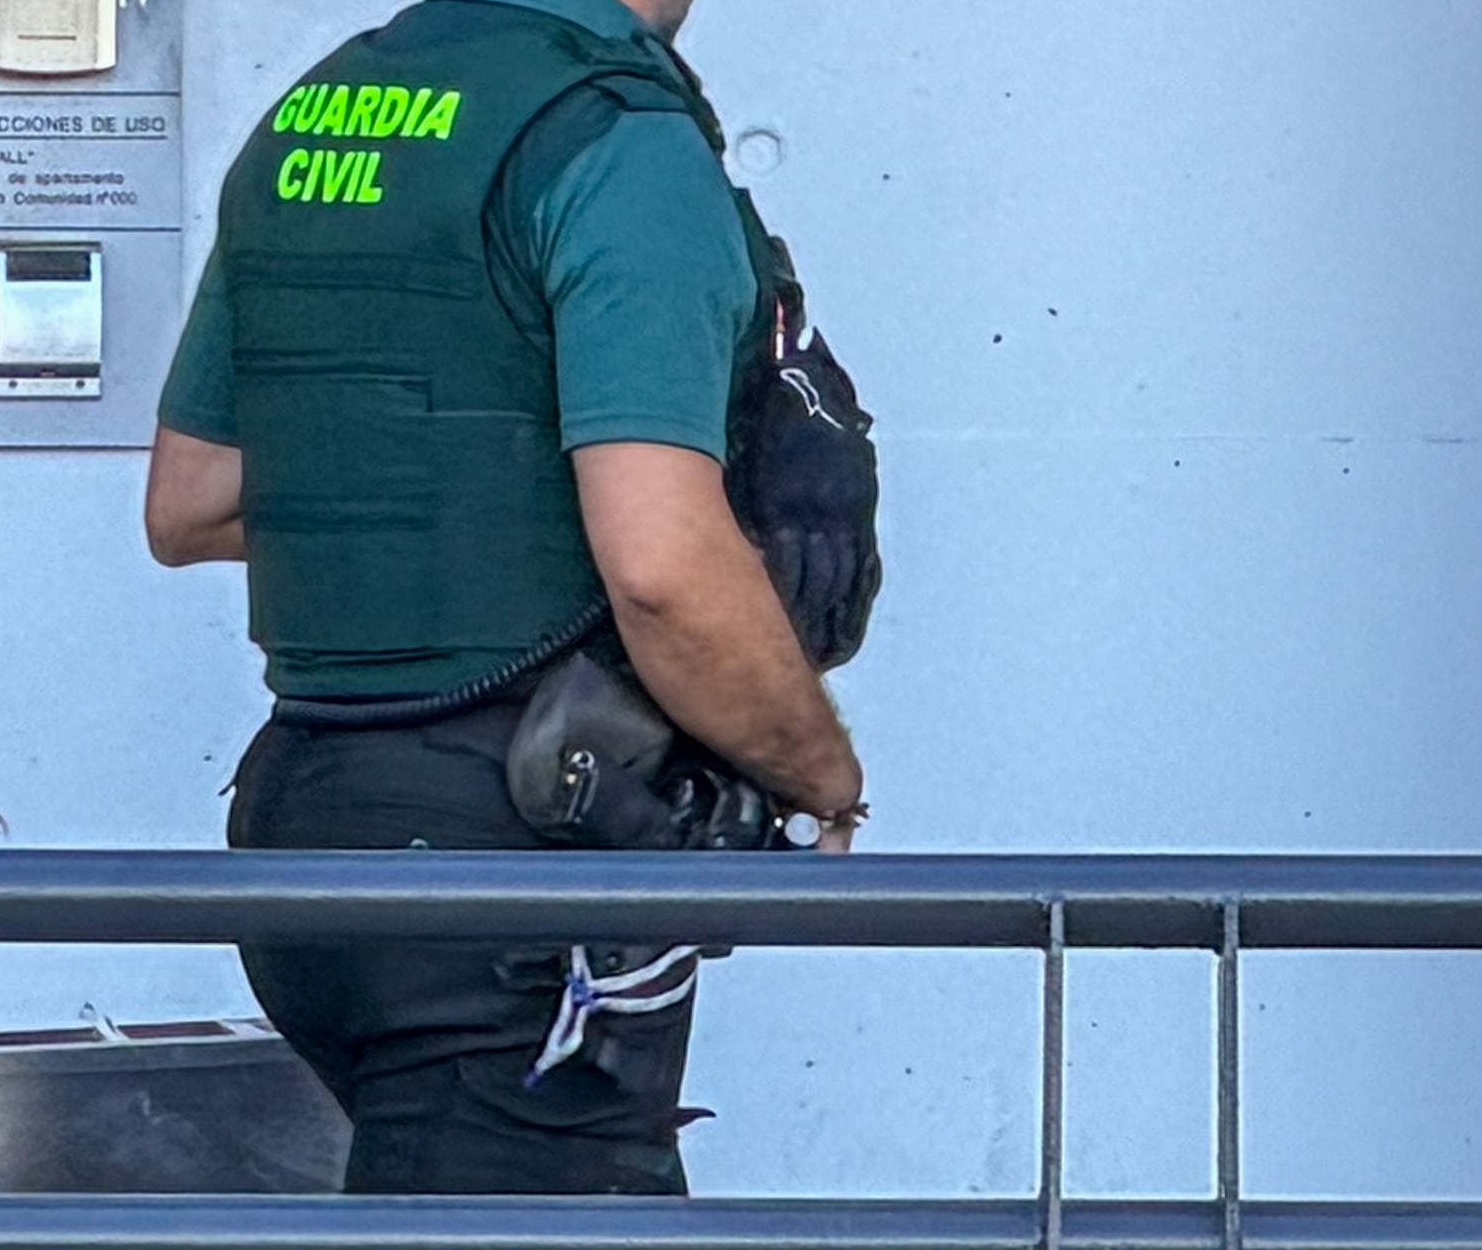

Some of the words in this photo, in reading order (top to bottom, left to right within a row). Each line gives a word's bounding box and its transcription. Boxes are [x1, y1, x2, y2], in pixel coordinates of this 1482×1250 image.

[272, 83, 462, 140] GUARDIA
[91, 116, 117, 133] DE
[125, 116, 166, 133] USO
[7, 173, 27, 184] de
[34, 172, 125, 186] apartamento
[277, 148, 383, 204] CIVIL
[12, 191, 93, 206] Comunidad
